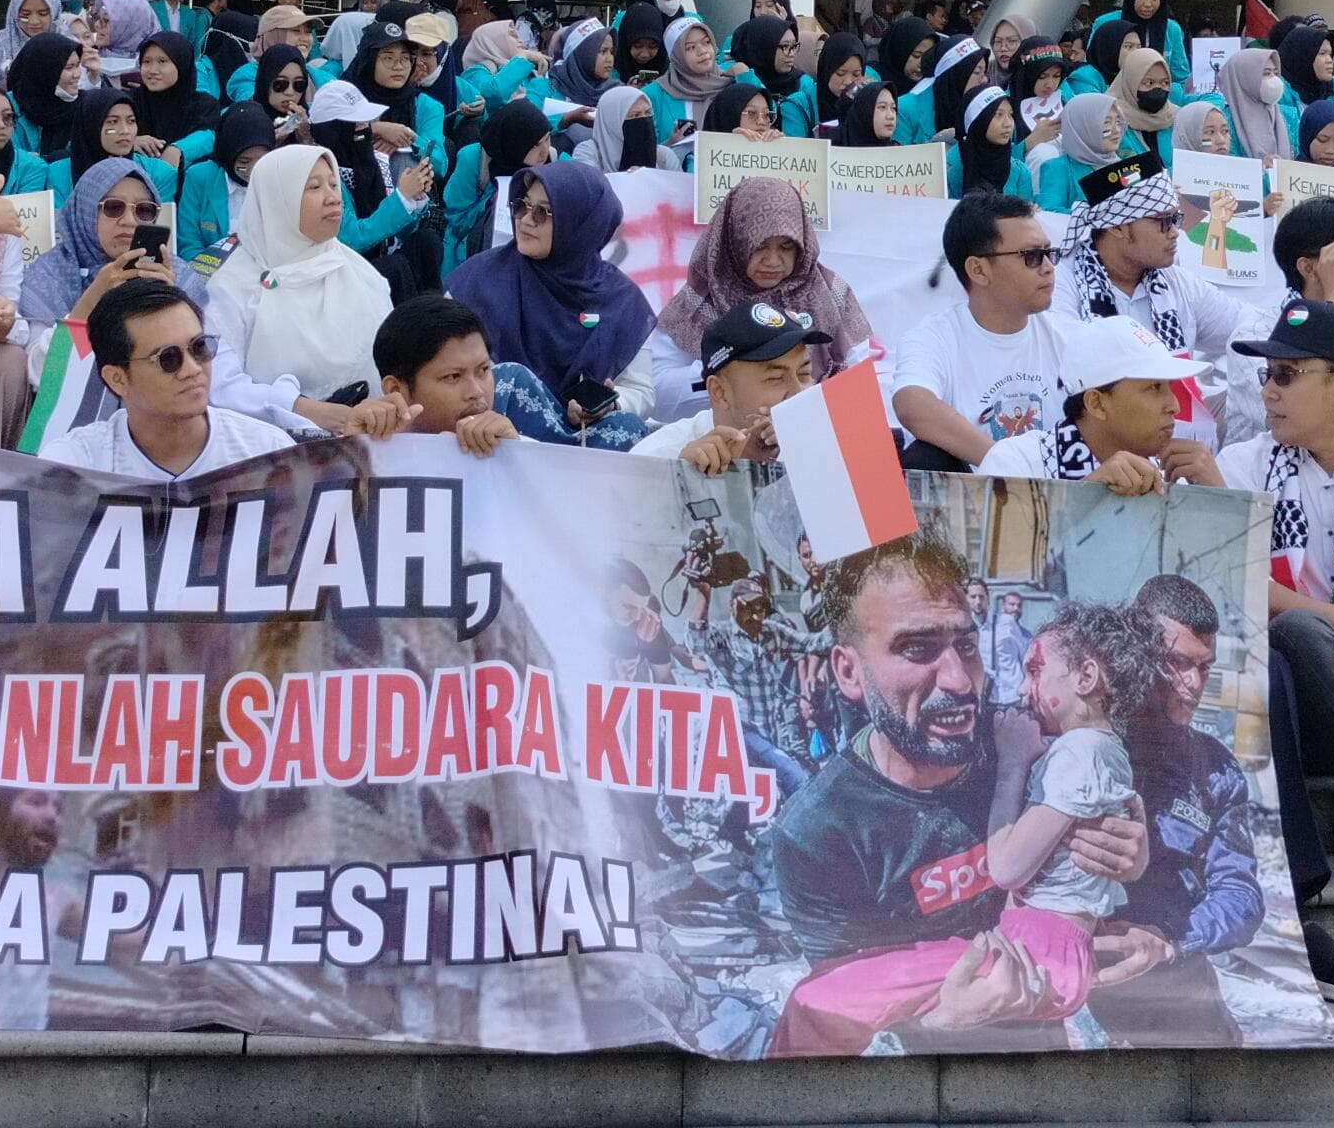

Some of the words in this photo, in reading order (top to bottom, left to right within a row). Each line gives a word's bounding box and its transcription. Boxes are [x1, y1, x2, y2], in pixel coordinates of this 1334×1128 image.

[710, 149, 817, 173] KEMERDEKAAN
[1193, 177, 1210, 186] SAVE
[1213, 180, 1250, 190] PALESTINE
[1235, 270, 1258, 278] UMS
[60, 480, 501, 634] ALLAH,
[216, 660, 567, 789] SAUDARA
[581, 676, 777, 822] KITA,
[77, 850, 641, 965] PALESTINA!
